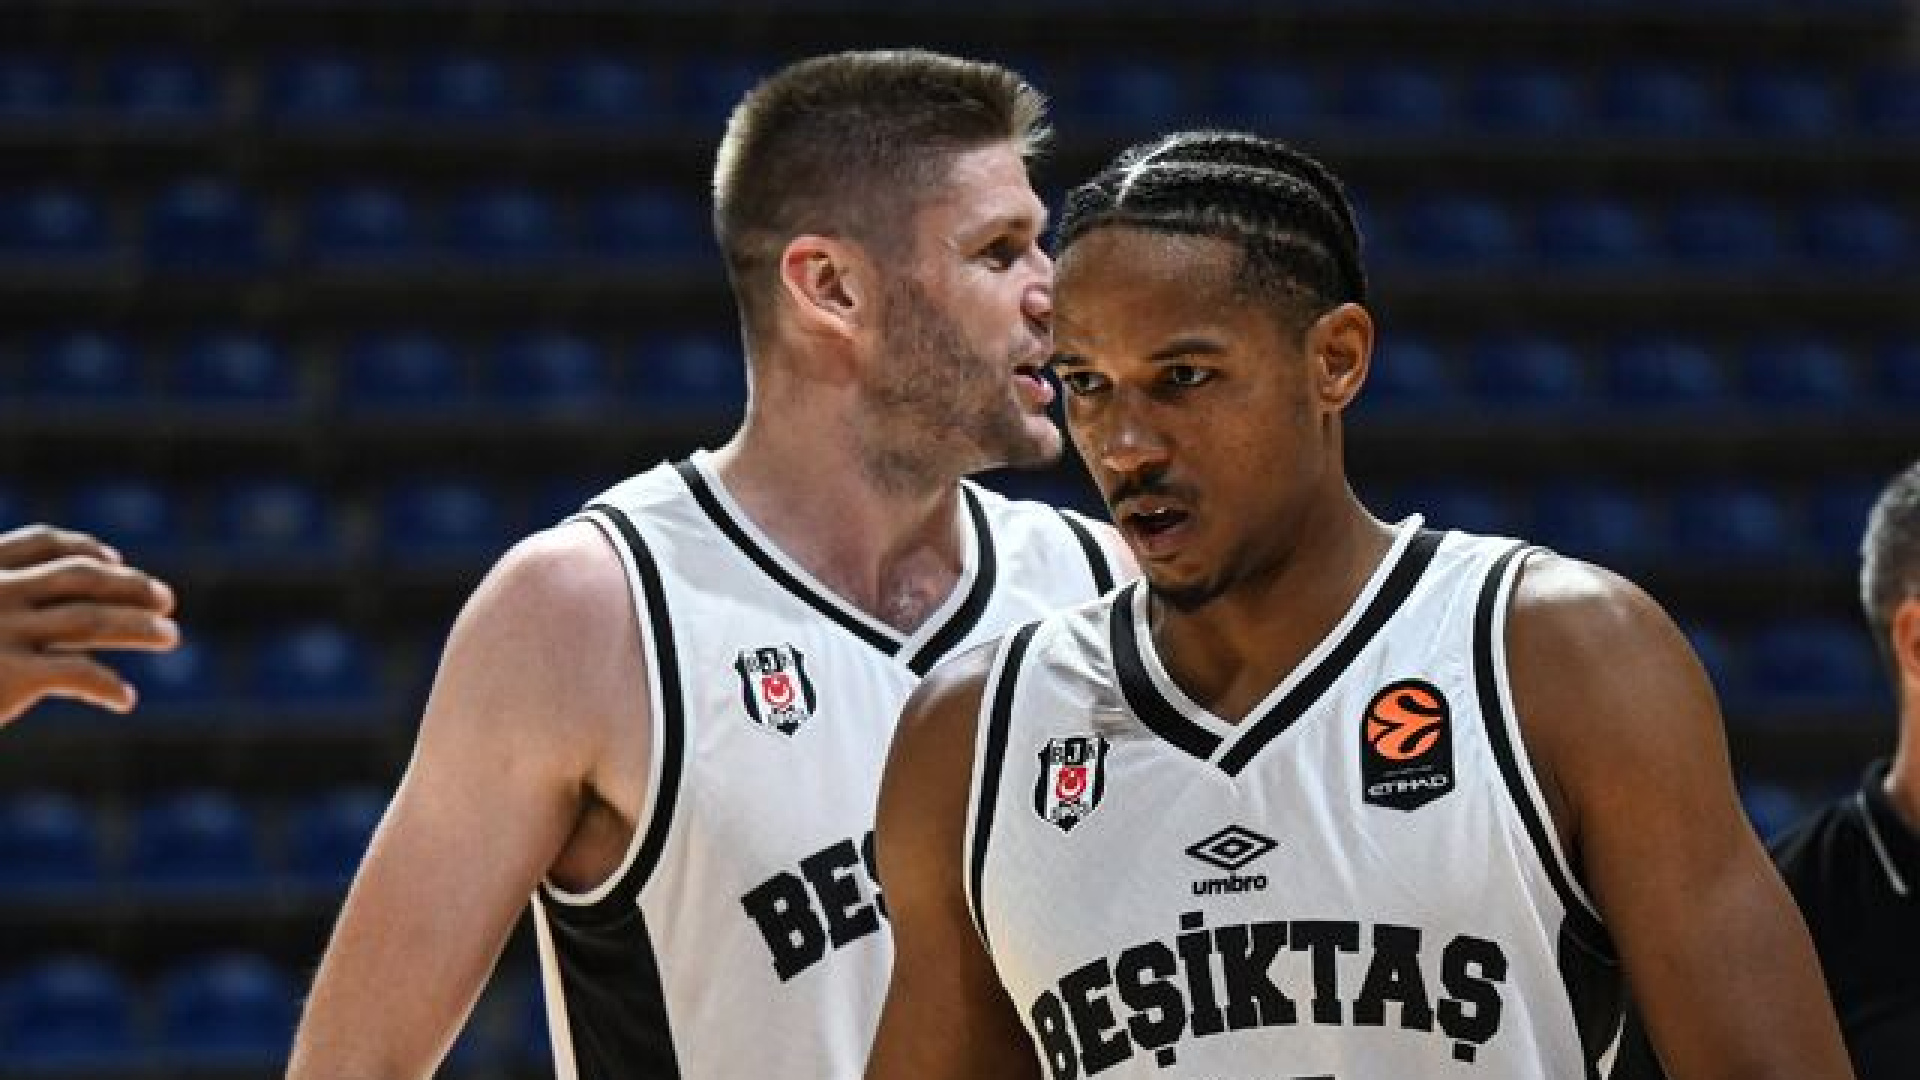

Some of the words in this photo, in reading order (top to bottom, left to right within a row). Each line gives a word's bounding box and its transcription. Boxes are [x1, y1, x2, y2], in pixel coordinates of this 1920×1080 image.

[739, 830, 889, 982] BE
[1191, 874, 1268, 896] umbro
[1029, 910, 1508, 1080] BEŞİKTAŞ
